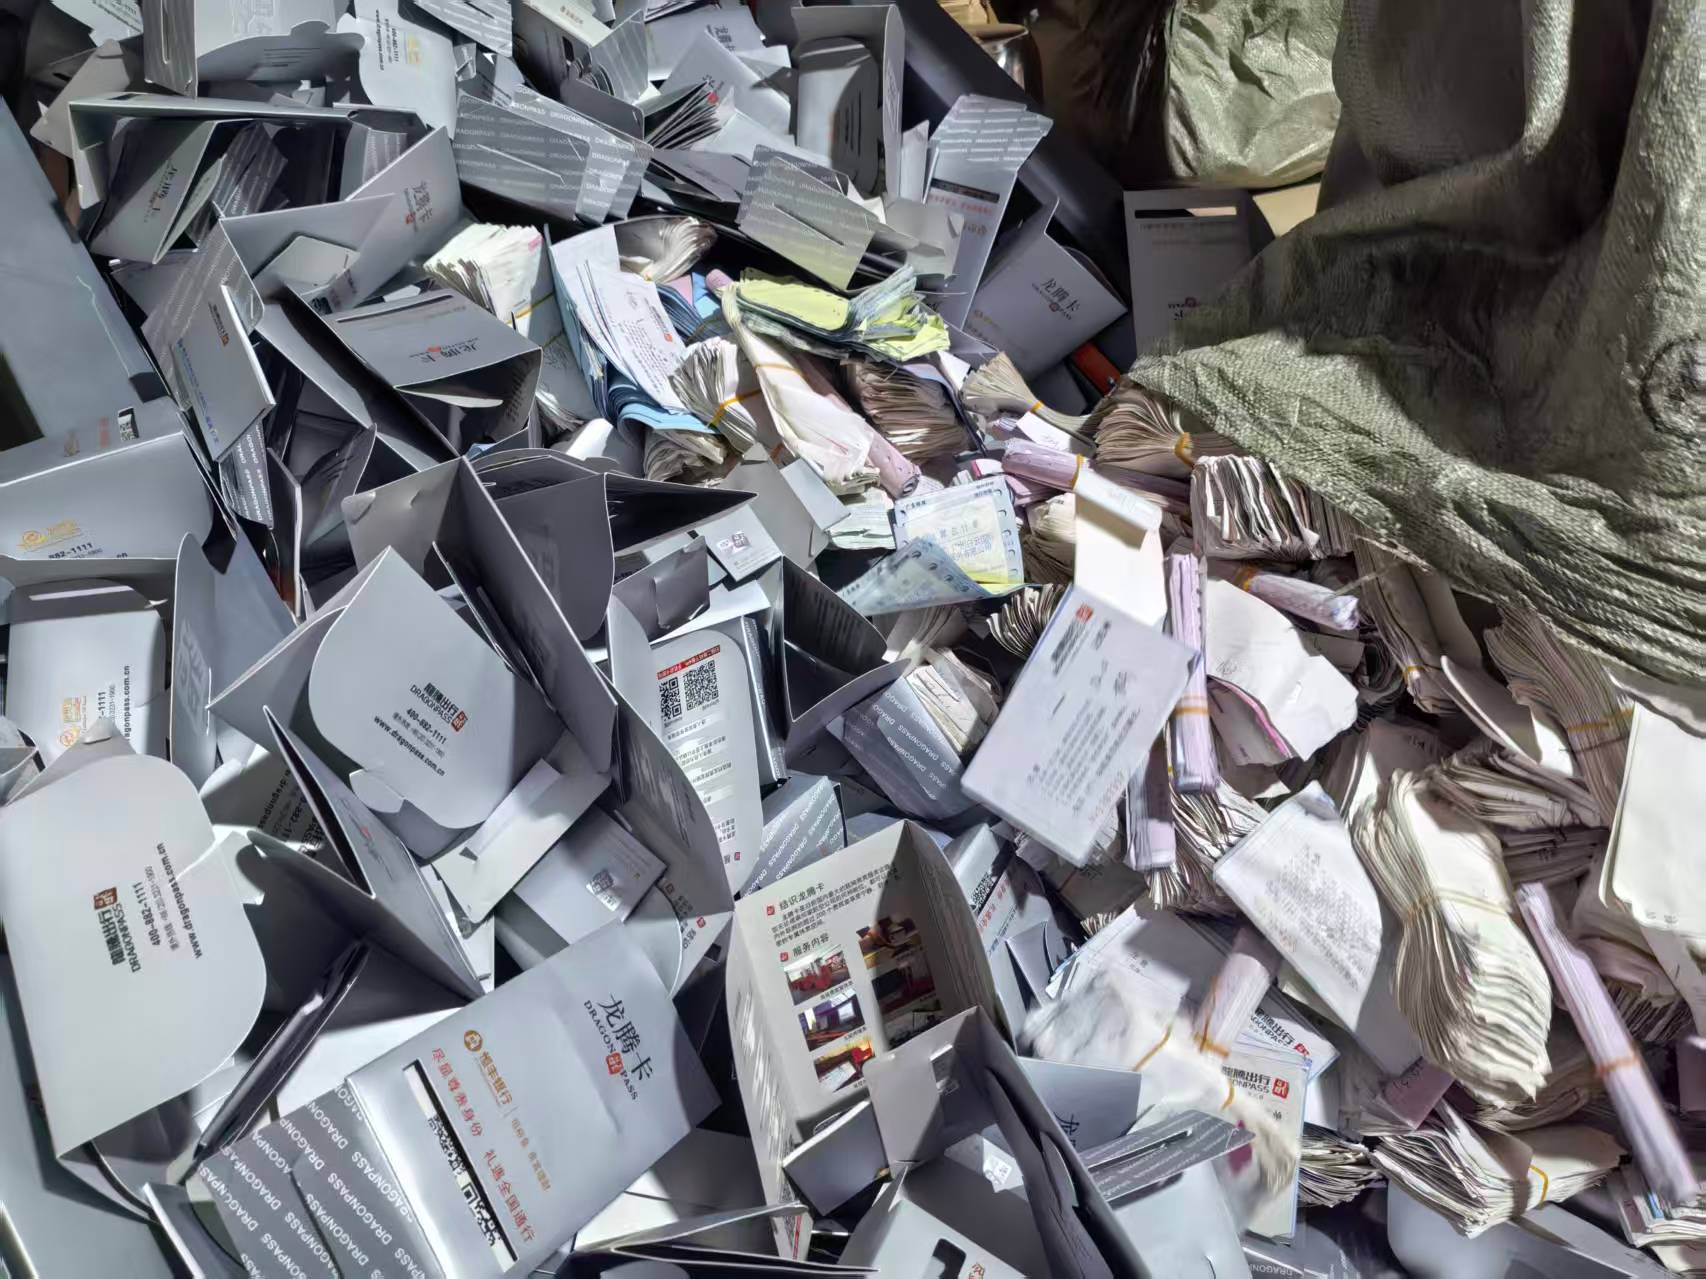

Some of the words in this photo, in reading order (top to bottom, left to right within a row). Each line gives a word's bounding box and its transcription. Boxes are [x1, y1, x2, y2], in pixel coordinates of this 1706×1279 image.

[122, 665, 131, 738] agonpass.com.cn
[409, 684, 453, 725] DRAGONPASS
[373, 715, 446, 777] www.dragonpass.com.cn
[112, 902, 142, 973] DRAGONPASS
[157, 843, 203, 959] www.dragonpass.com.cn
[597, 993, 653, 1081] 龙腾卡
[305, 1192, 370, 1267] DRAGONPASS
[327, 1172, 393, 1246] DRAGONPASS
